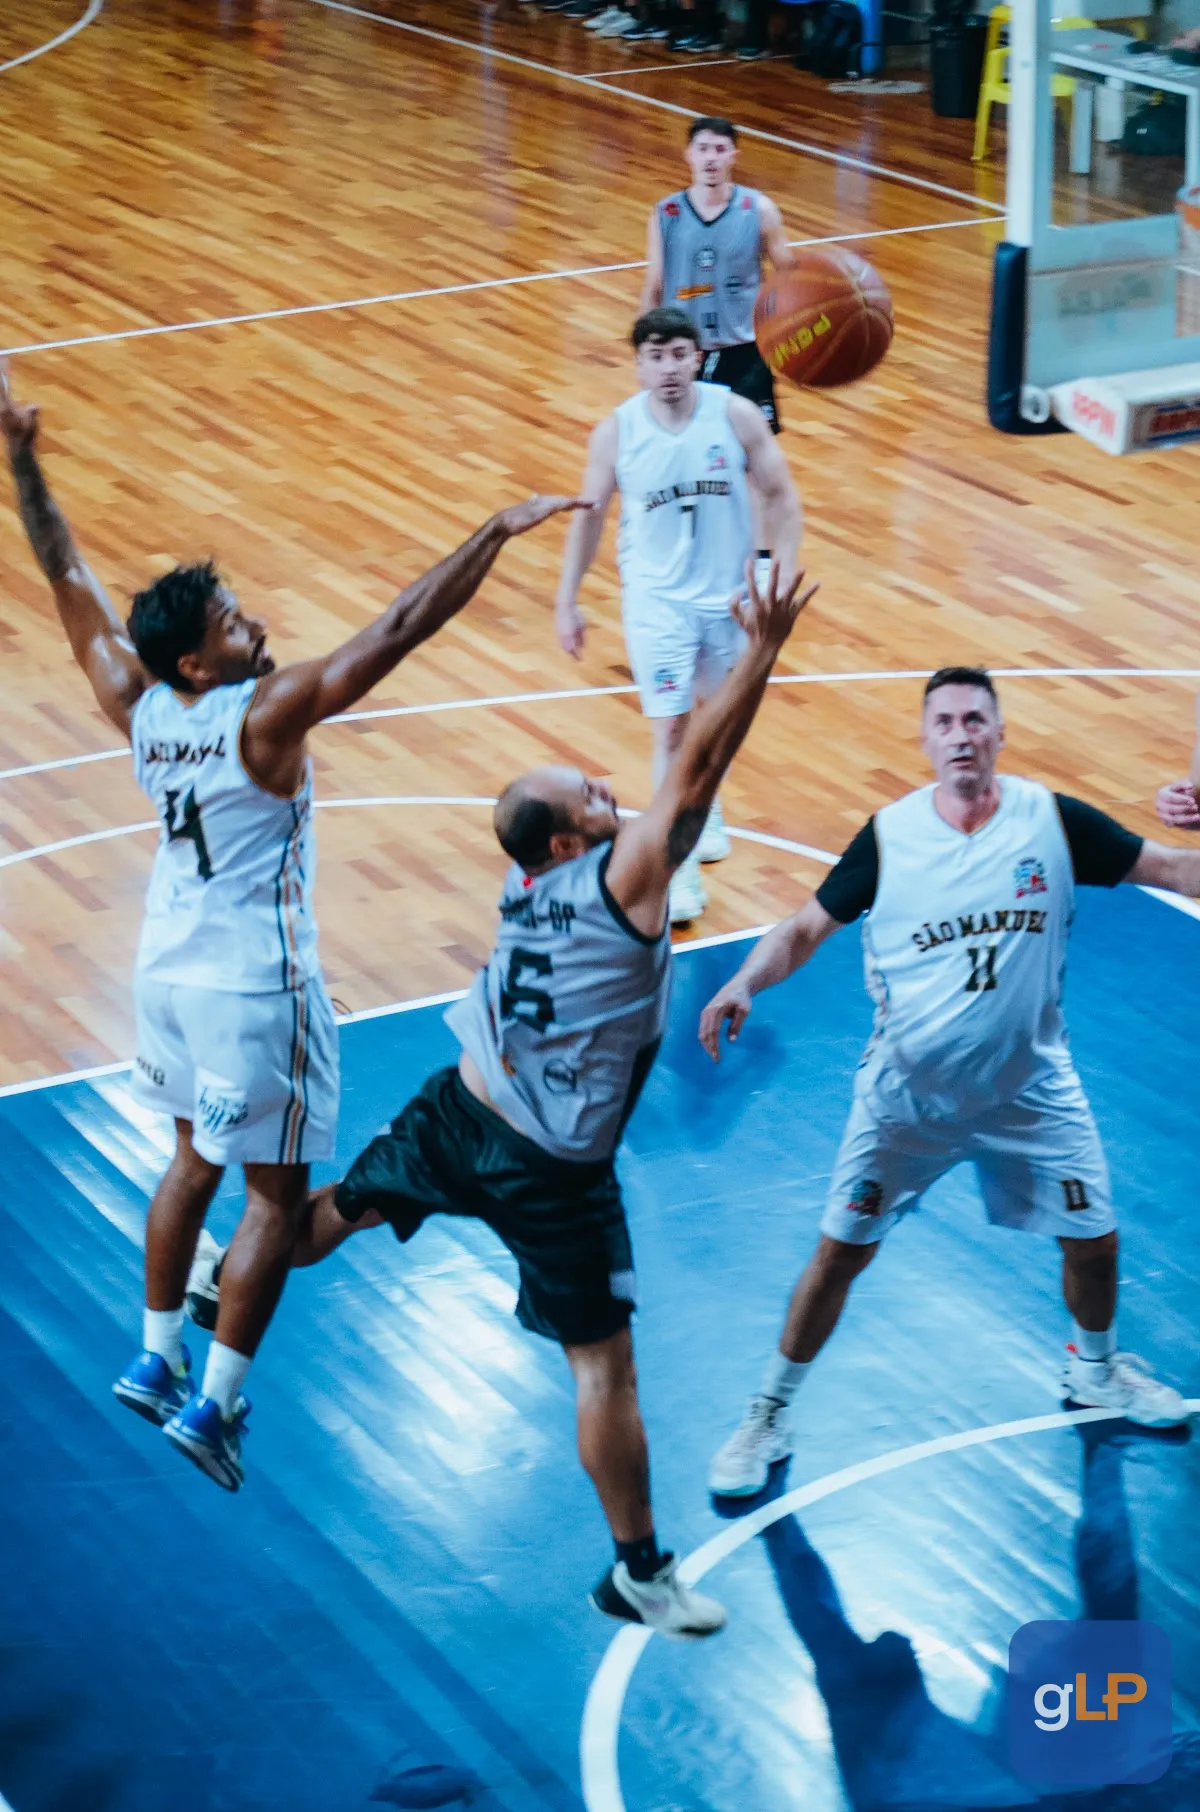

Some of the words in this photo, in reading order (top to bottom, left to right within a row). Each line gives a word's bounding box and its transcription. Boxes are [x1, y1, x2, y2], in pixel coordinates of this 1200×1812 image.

[911, 921, 955, 953] SÃO
[957, 909, 1049, 938] MANUEL
[501, 945, 556, 1034] 6
[965, 944, 997, 992] 11
